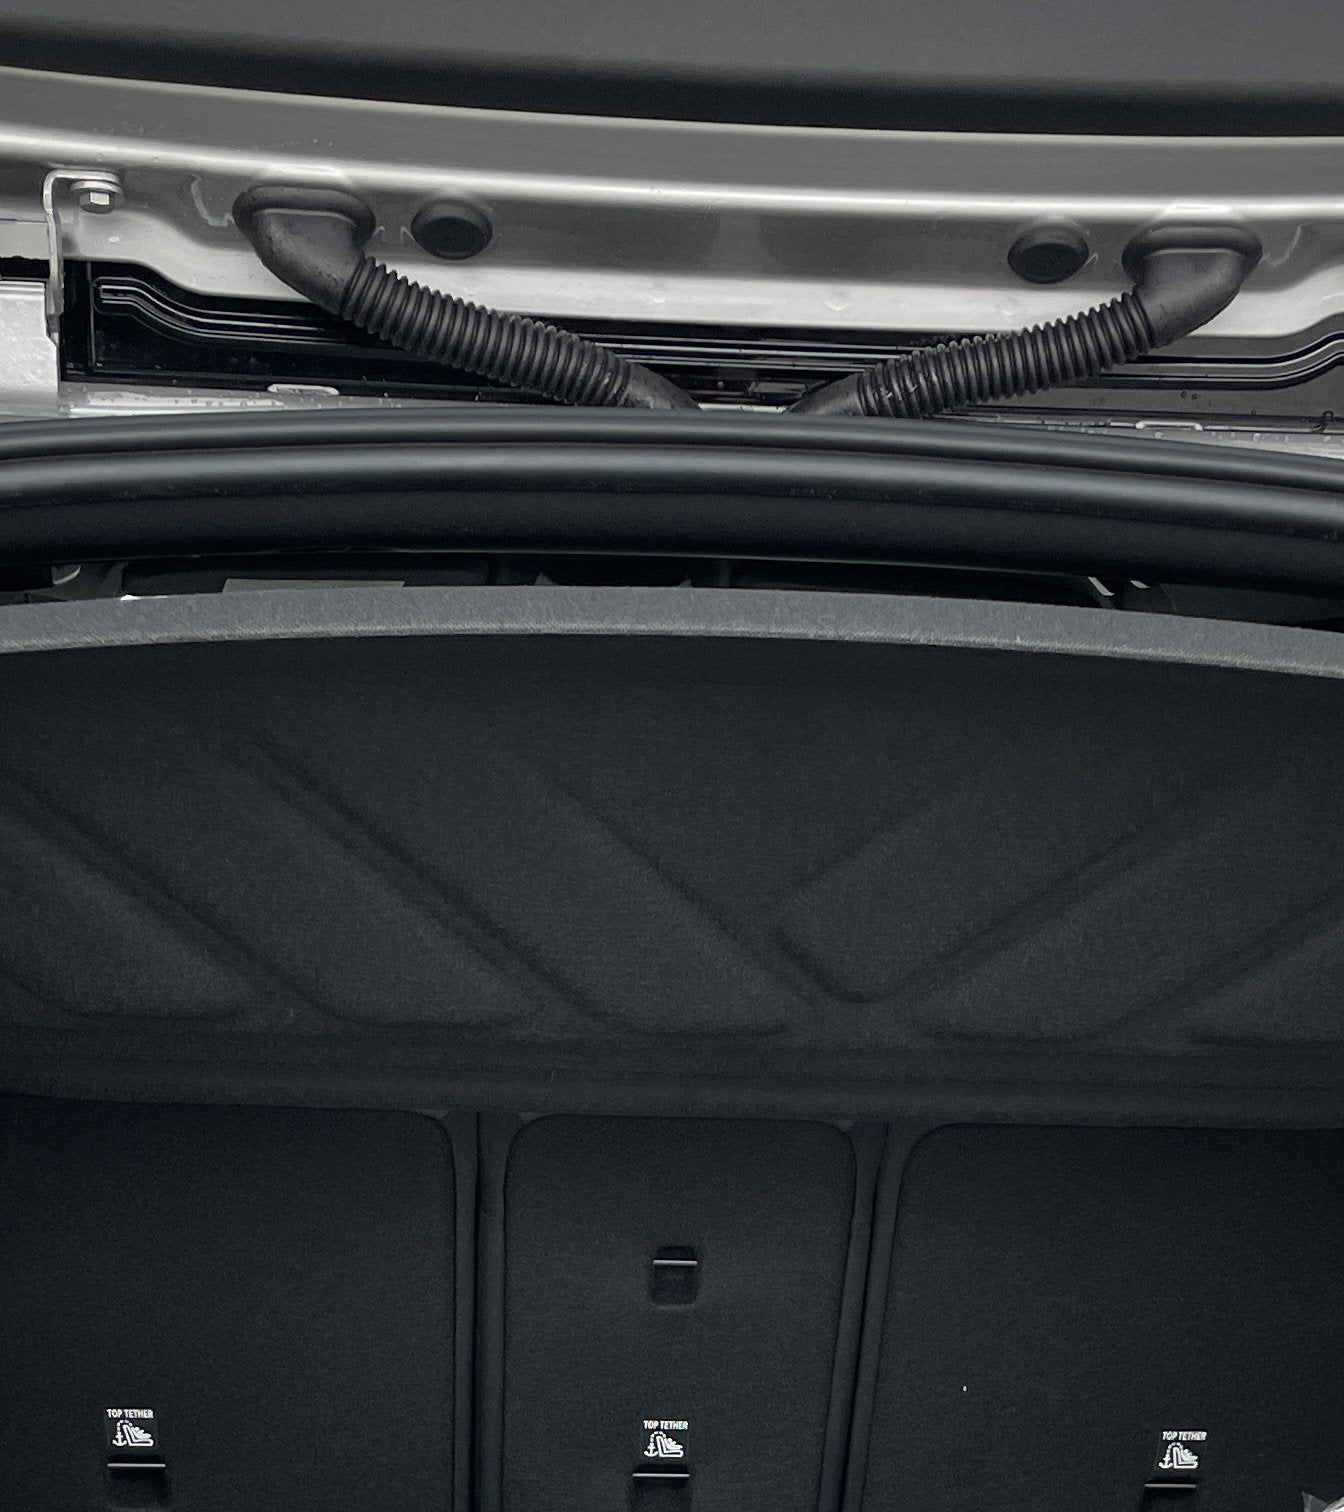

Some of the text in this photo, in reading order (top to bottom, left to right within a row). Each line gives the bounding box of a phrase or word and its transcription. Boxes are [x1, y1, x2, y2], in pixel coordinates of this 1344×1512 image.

[106, 1409, 154, 1418] TOP TETHER
[643, 1420, 689, 1430] TOP TETHER
[1162, 1431, 1207, 1441] TOP TETHER
